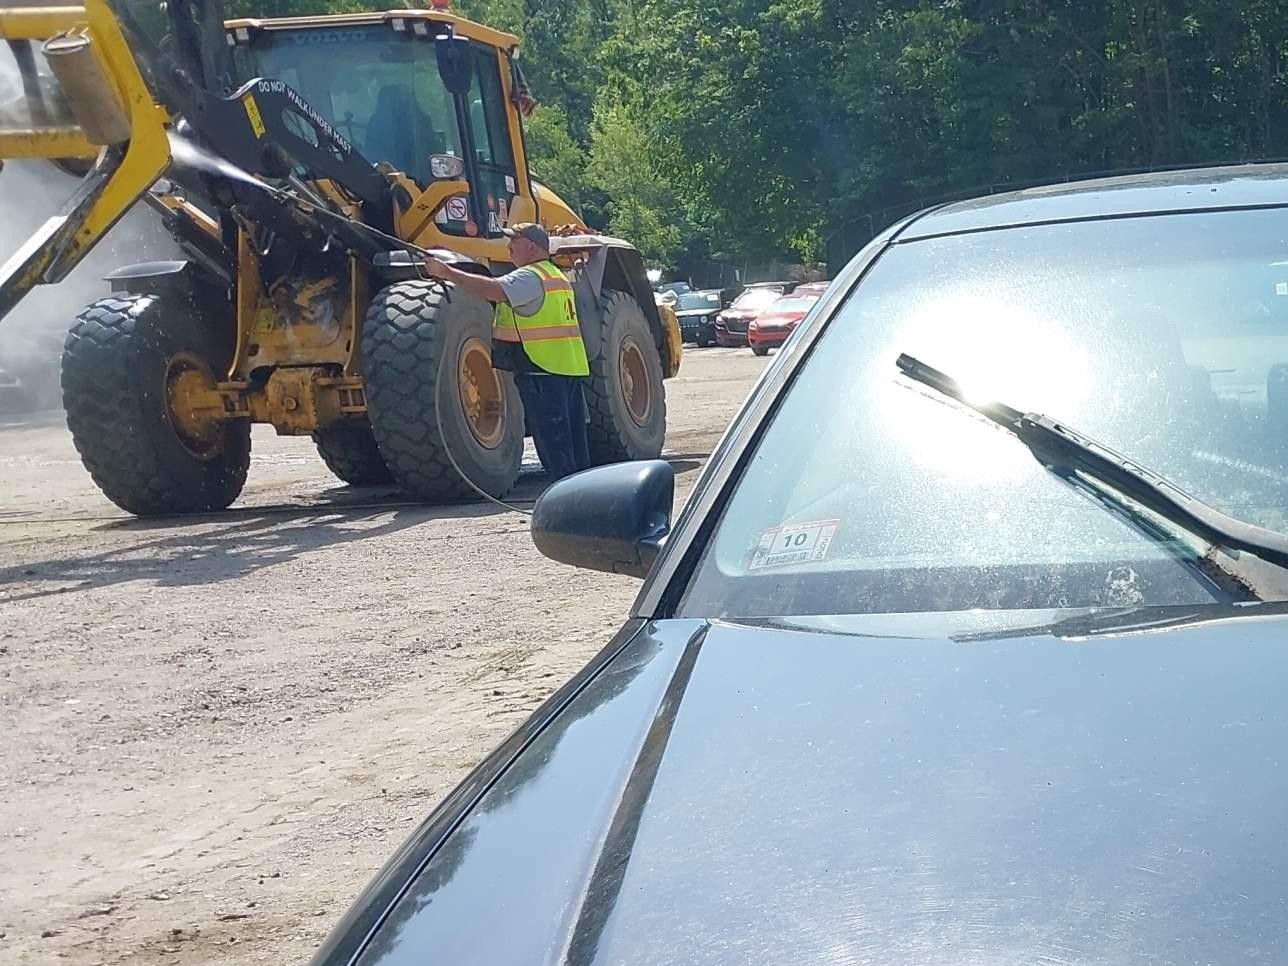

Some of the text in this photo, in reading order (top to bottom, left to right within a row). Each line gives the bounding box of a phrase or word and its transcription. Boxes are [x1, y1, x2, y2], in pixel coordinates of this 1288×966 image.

[258, 81, 353, 155] DO NOT WALK UNDER MAST
[784, 533, 808, 547] 10
